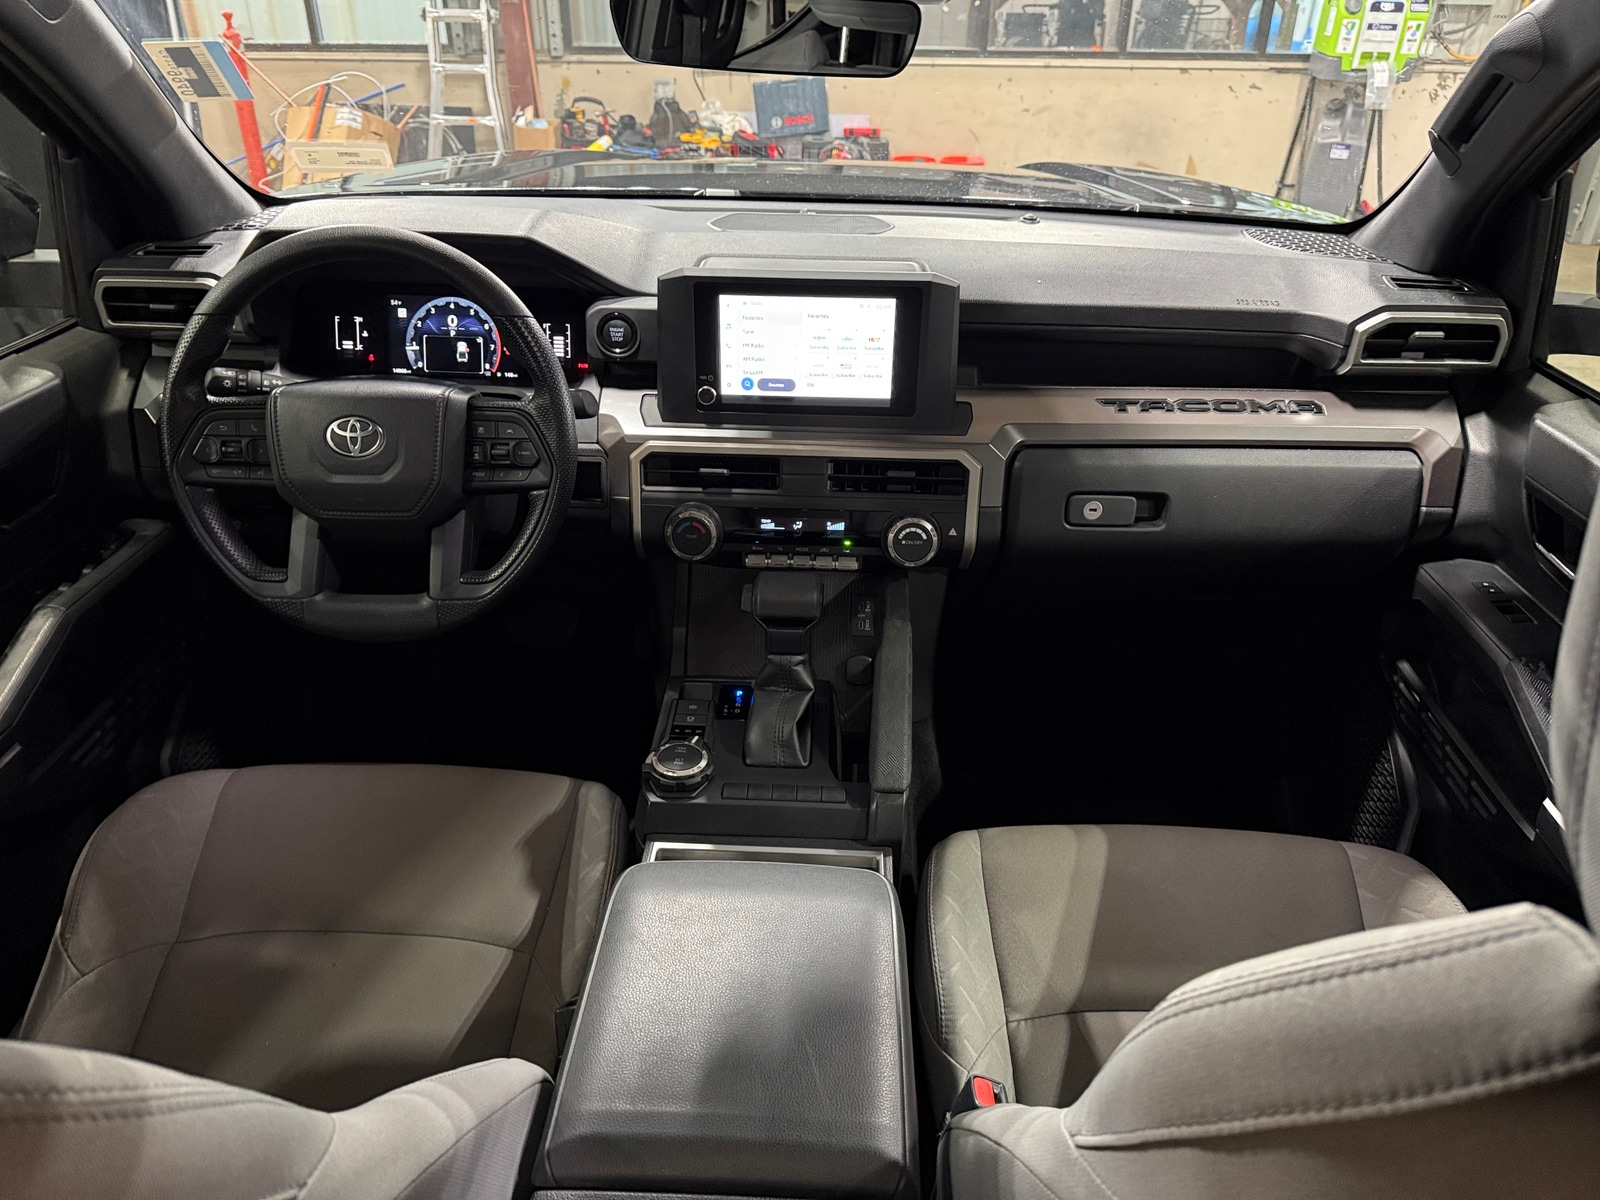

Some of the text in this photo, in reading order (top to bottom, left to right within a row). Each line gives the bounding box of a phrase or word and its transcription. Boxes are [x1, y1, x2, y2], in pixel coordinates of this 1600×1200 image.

[784, 114, 815, 126] BOSCH
[447, 314, 458, 327] 0
[1095, 398, 1328, 416] TACOMA
